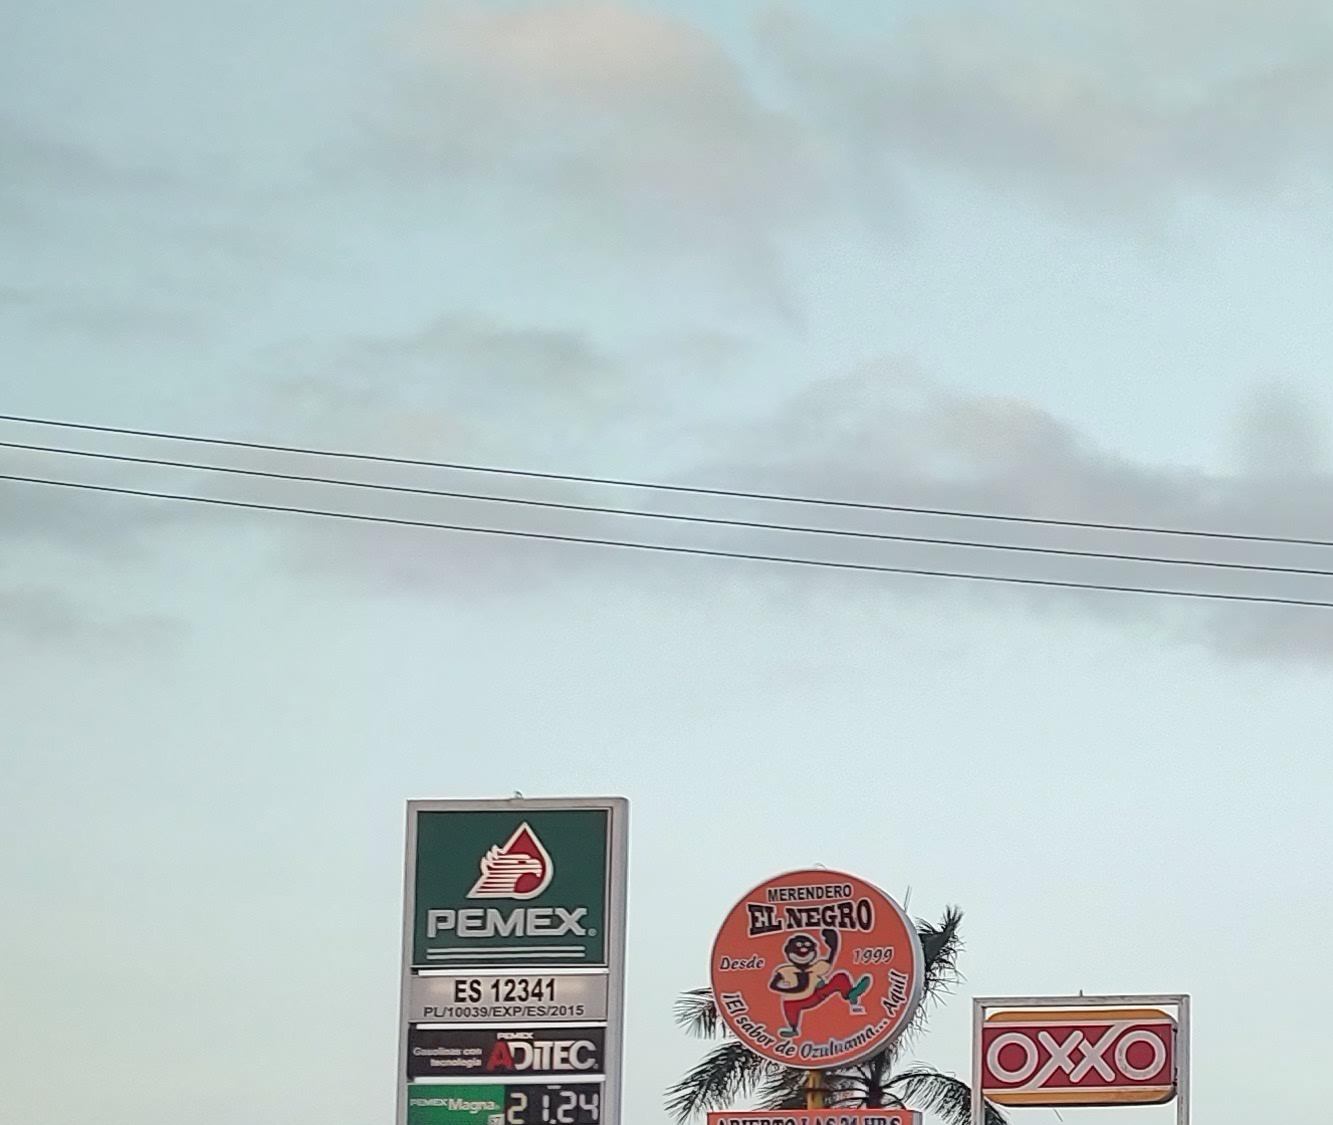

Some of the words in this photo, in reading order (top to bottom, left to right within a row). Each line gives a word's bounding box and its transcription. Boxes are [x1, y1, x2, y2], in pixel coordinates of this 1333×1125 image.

[768, 885, 852, 901] MERENDERO
[427, 908, 587, 938] PEMEX
[748, 904, 782, 935] EL
[785, 899, 872, 931] NEGRO
[720, 955, 763, 970] Desde
[854, 947, 893, 963] 1999
[454, 979, 482, 1003] ES
[491, 978, 556, 1002] 12341
[423, 1005, 585, 1018] PL/10039/EXP/ES/2015
[736, 1016, 774, 1047] sabor
[774, 1040, 796, 1057] de
[986, 1028, 1167, 1087] OXXO
[410, 1098, 447, 1107] PEMEX
[448, 1098, 495, 1114] Magna
[507, 1091, 599, 1125] 21.24
